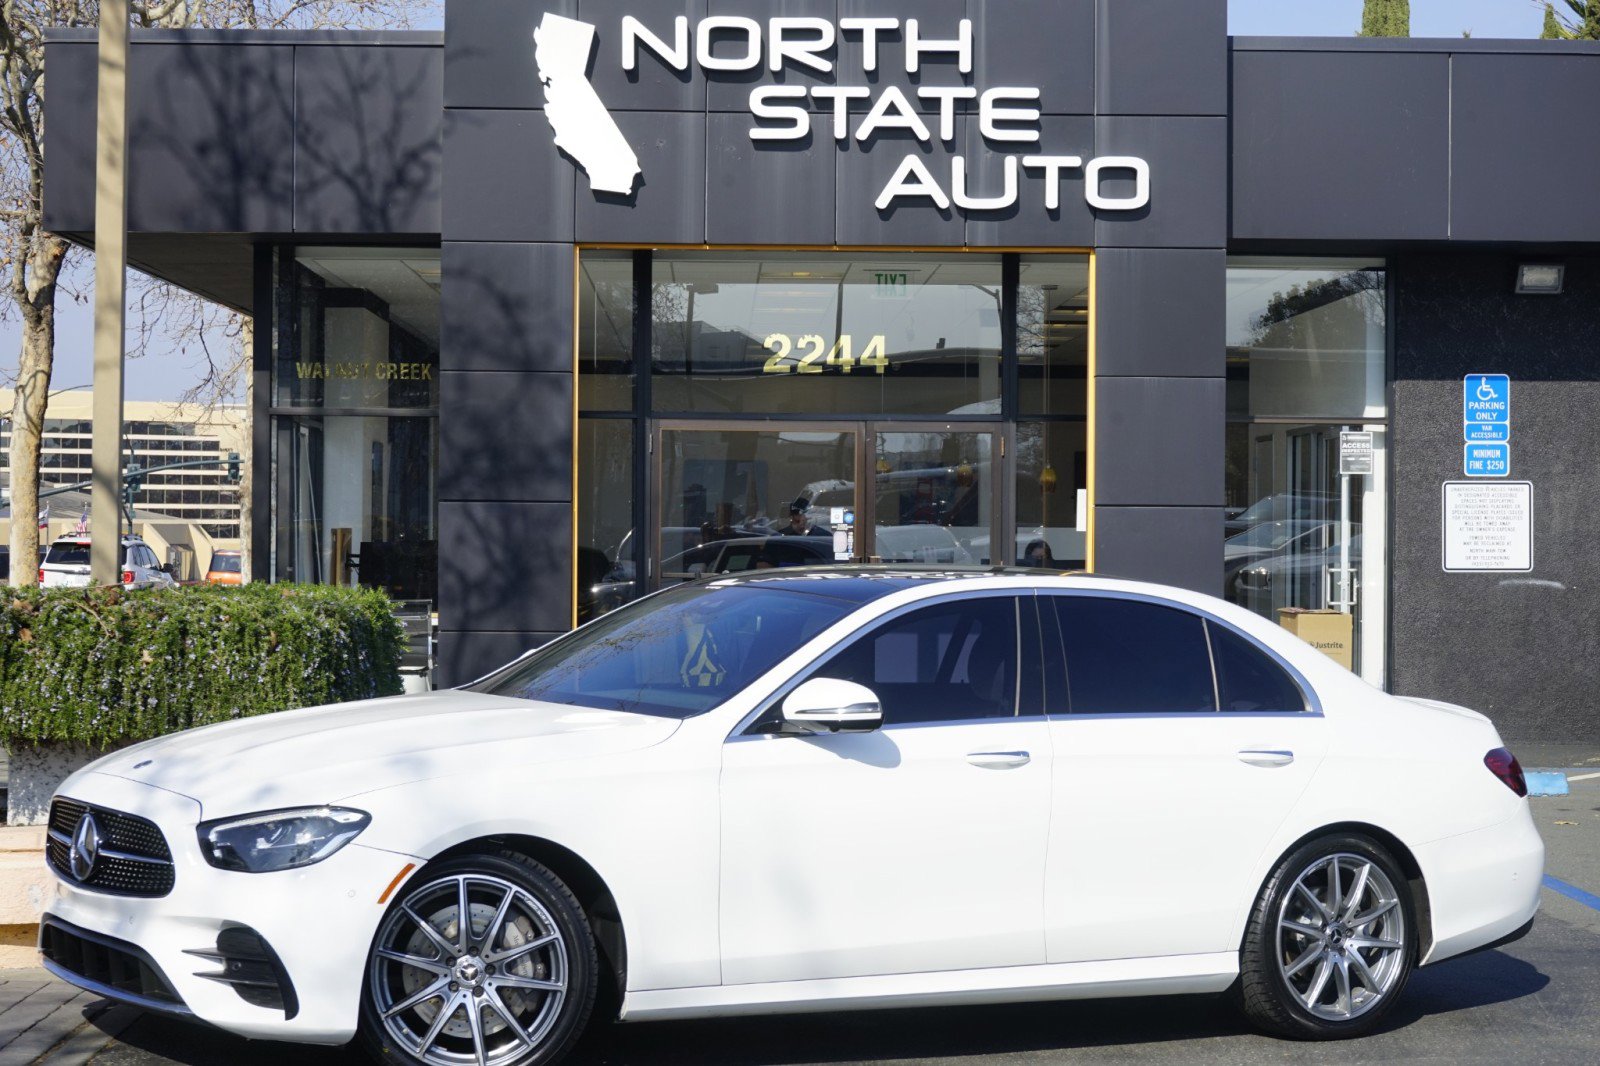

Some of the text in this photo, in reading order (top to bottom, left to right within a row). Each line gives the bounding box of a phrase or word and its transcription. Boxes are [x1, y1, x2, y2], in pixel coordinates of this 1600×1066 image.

[621, 15, 972, 74] NORTH
[748, 84, 1040, 142] STATE
[874, 153, 1151, 211] AUTO
[763, 333, 889, 374] 2244
[375, 361, 432, 381] CREEK
[1468, 401, 1505, 410] PARKING
[1475, 412, 1498, 420] ONLY
[1472, 449, 1501, 458] MINIMUM
[1469, 460, 1505, 470] FINE $250
[1315, 641, 1344, 649] Justrite
